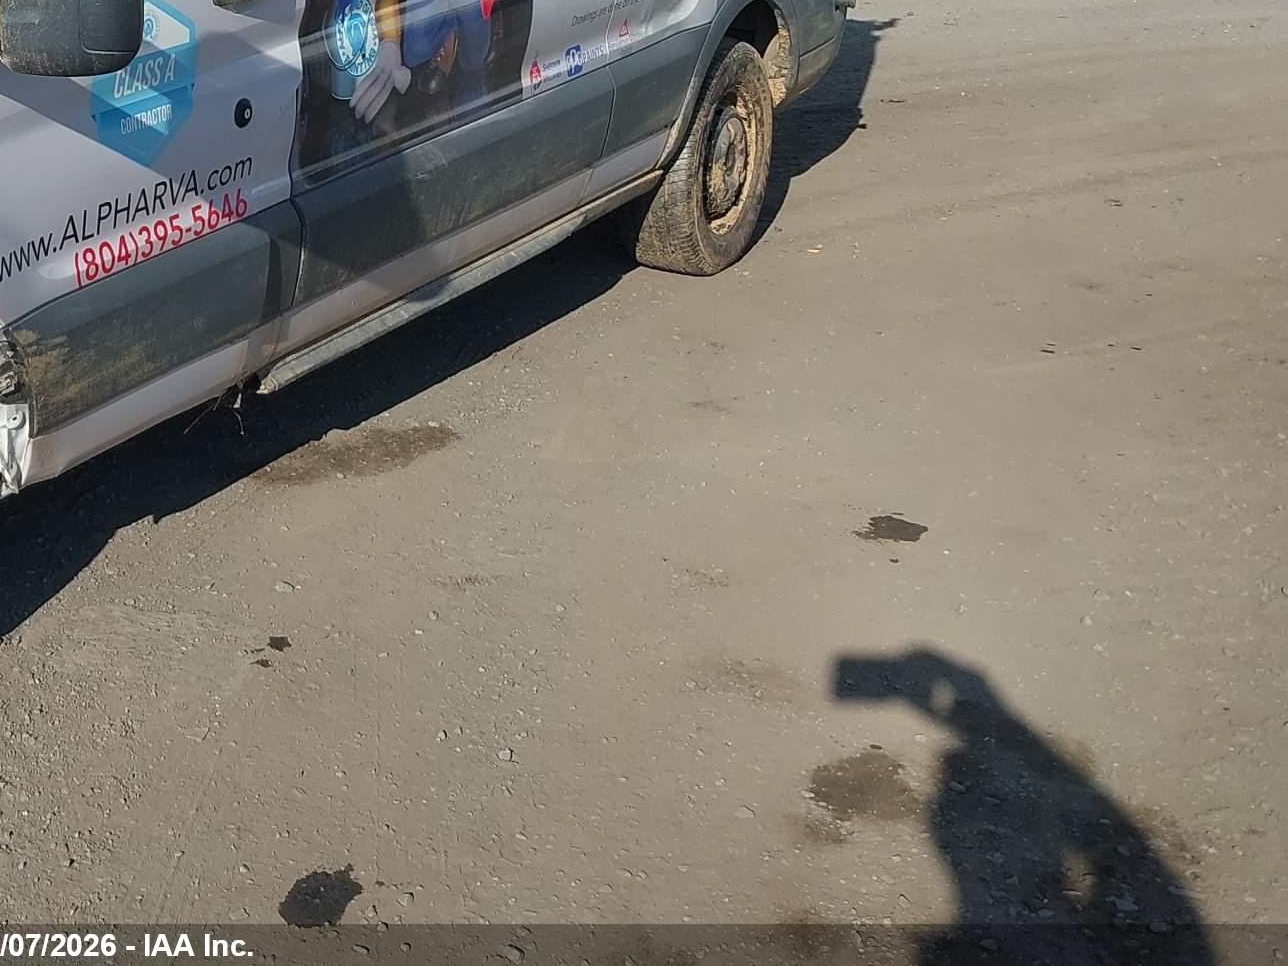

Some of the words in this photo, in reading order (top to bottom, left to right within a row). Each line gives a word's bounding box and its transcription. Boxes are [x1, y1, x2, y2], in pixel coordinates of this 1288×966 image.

[112, 53, 165, 100] CLASS
[163, 52, 177, 82] A
[119, 102, 173, 135] CONTRACTOR
[73, 186, 249, 290] (804)395-5646
